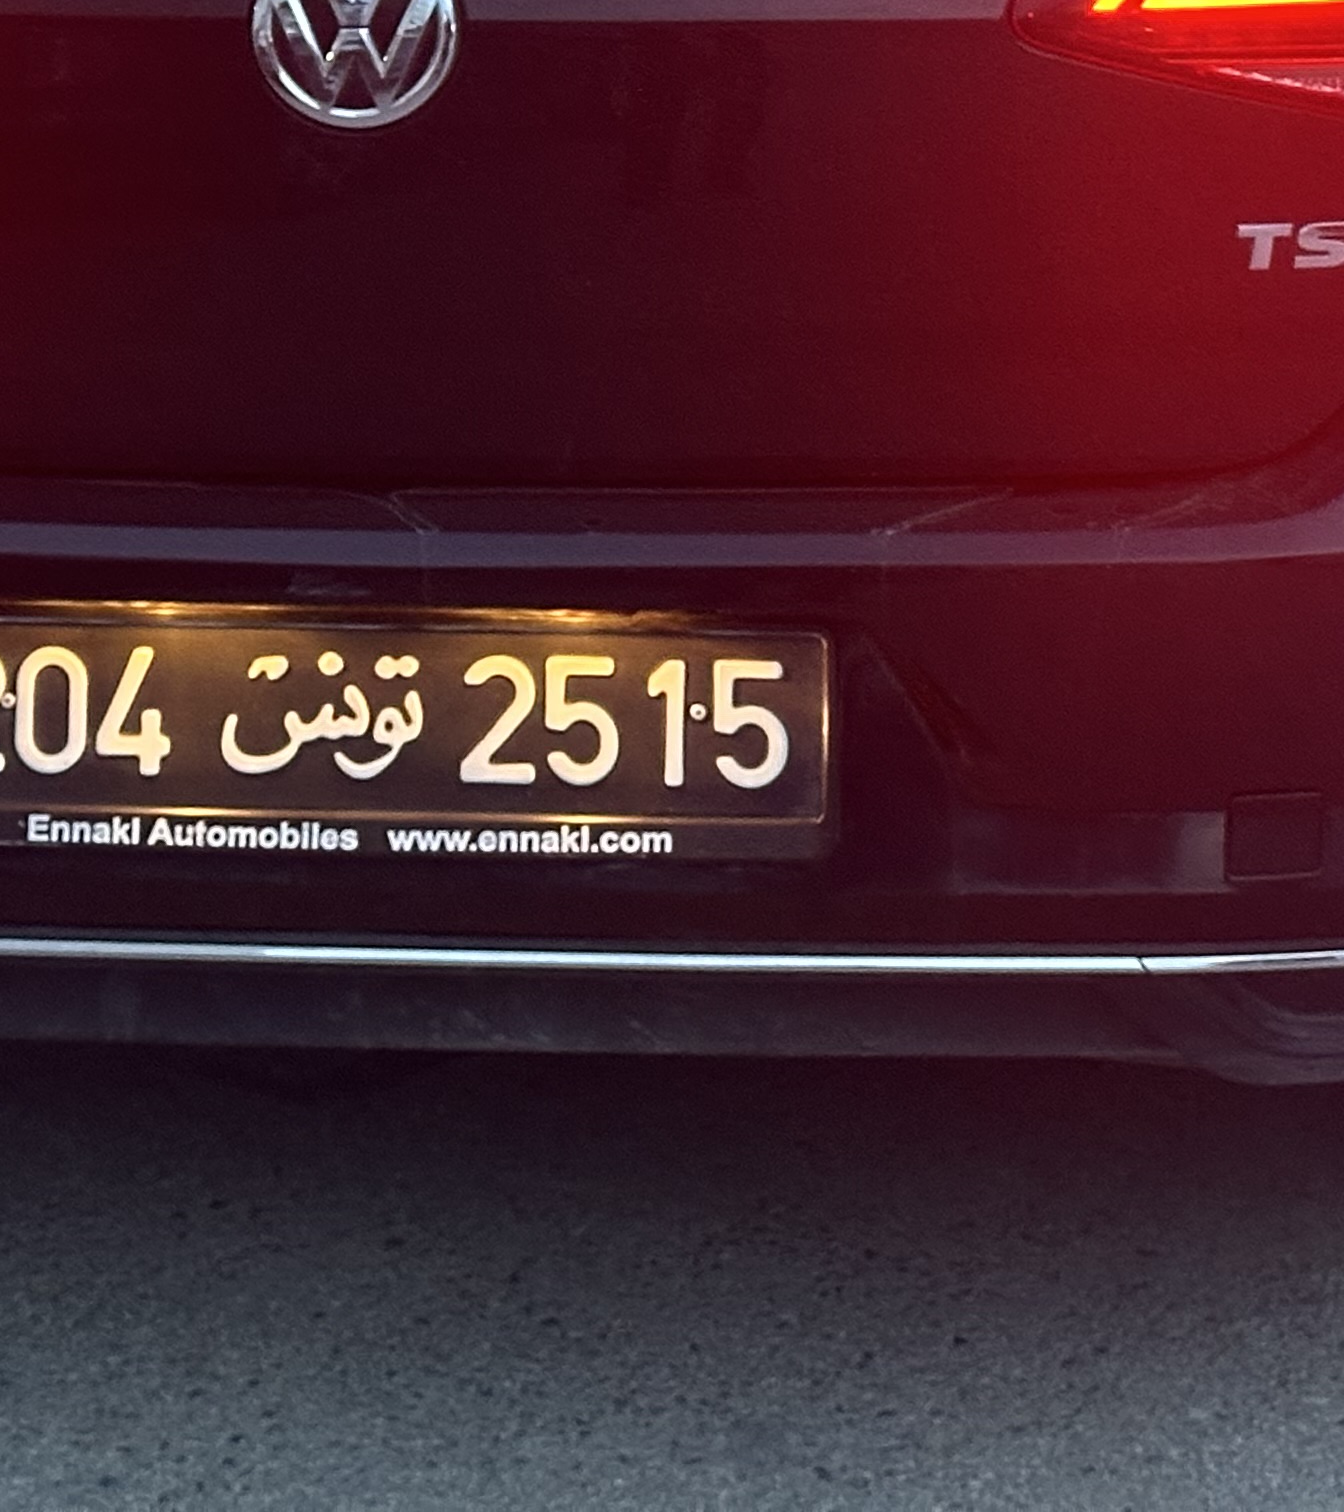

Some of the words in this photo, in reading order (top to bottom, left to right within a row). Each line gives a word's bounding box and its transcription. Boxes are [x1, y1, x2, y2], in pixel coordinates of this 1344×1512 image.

[220, 651, 424, 780] تونس
[459, 653, 790, 788] 2515
[148, 817, 359, 852] Automobiles
